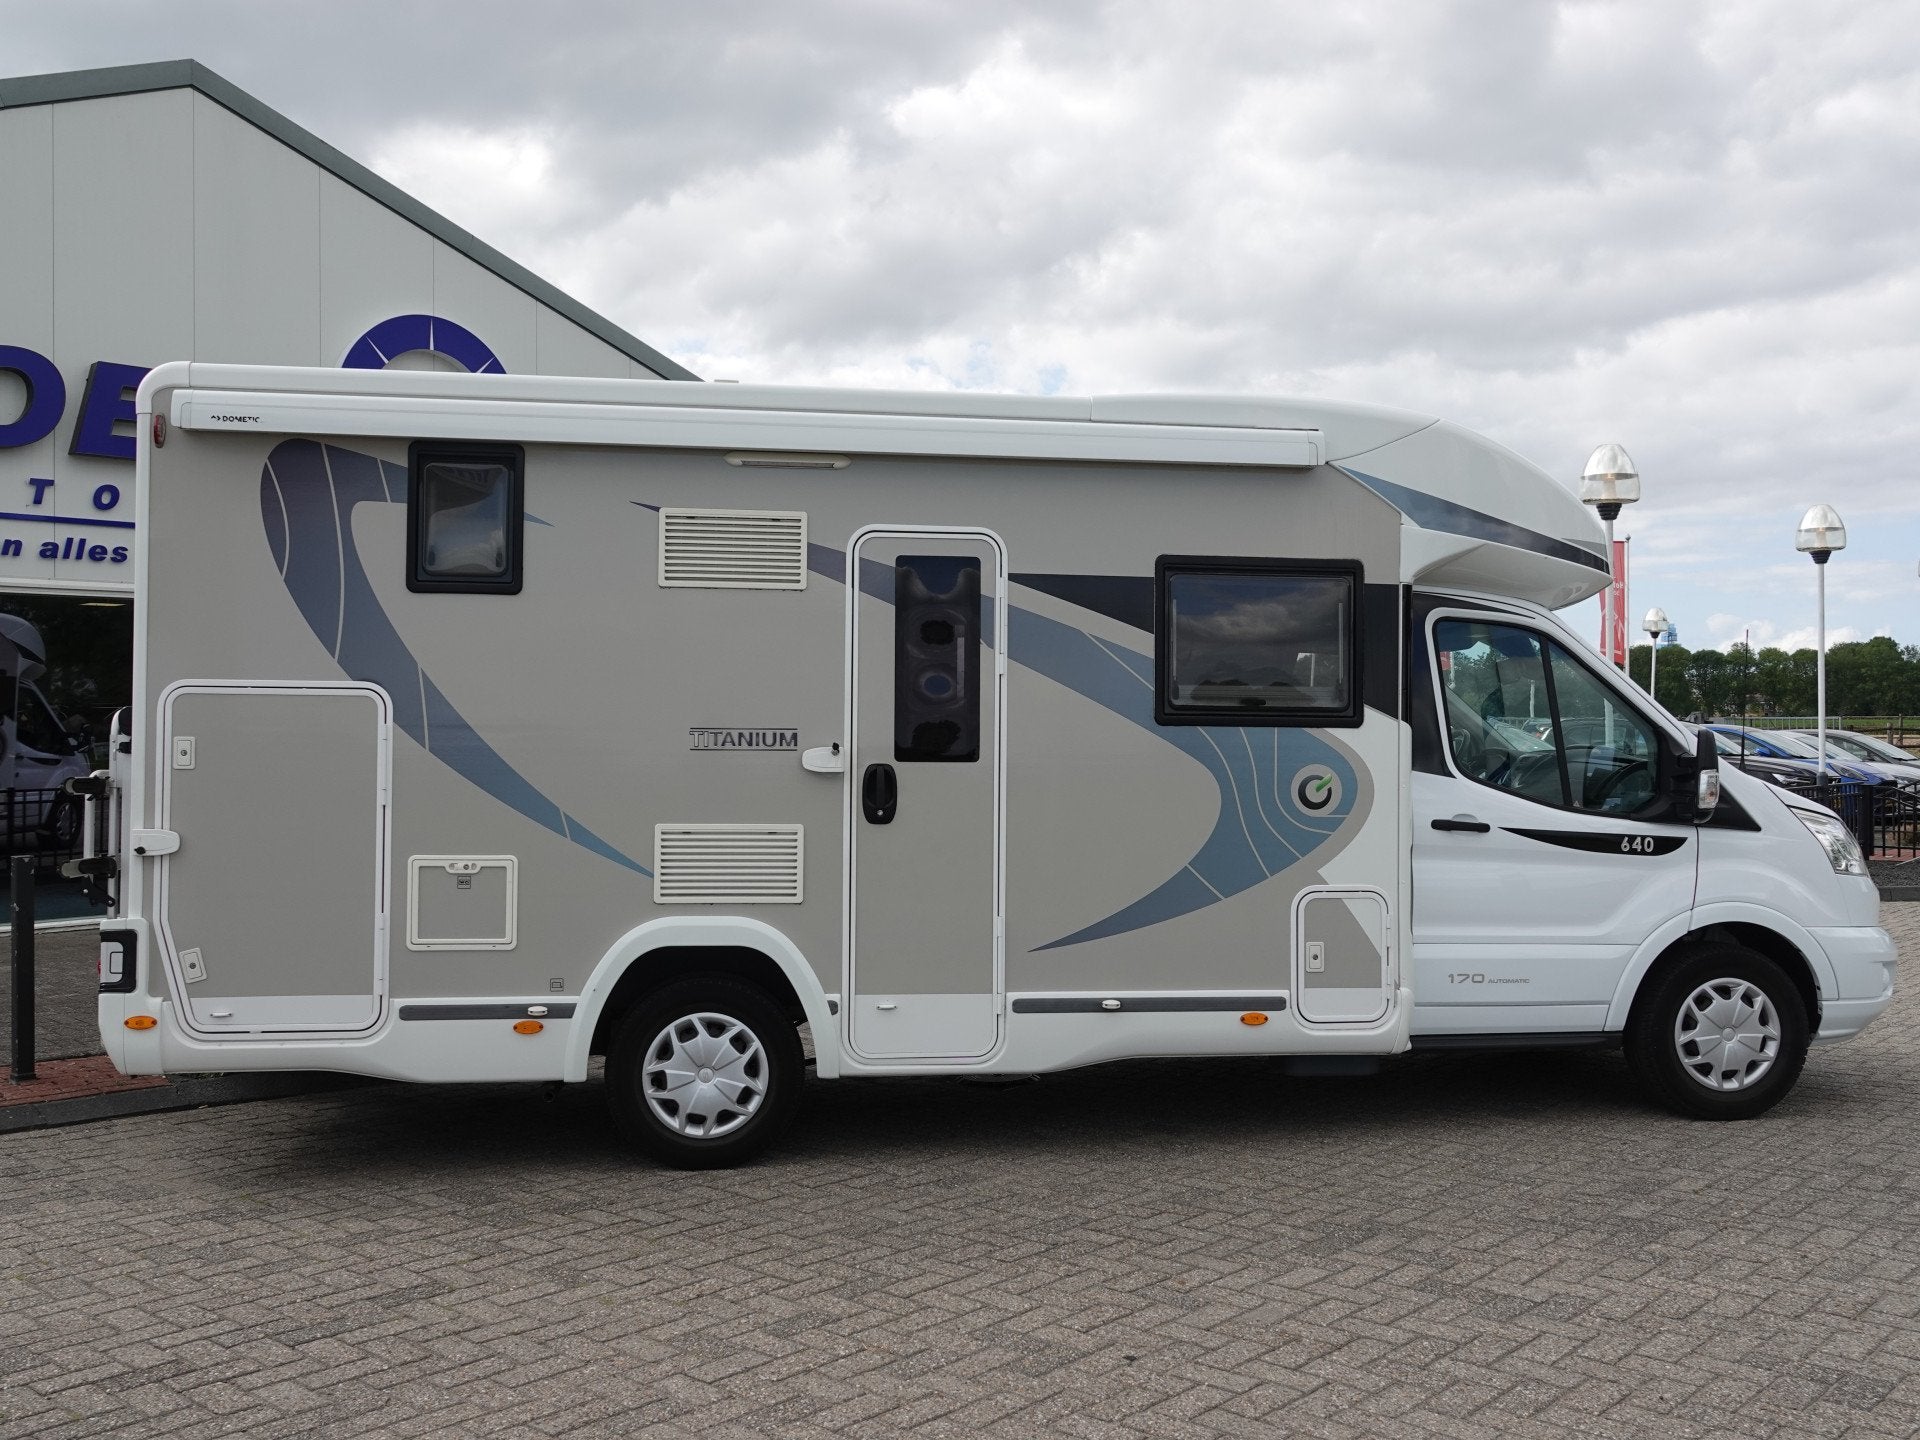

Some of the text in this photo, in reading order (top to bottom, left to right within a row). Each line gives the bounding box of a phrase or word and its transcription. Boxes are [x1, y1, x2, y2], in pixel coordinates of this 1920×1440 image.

[222, 415, 260, 423] DOMETIC
[39, 537, 129, 563] alles
[689, 730, 798, 748] TITANIUM
[1620, 836, 1655, 853] 640
[1448, 973, 1485, 984] 170
